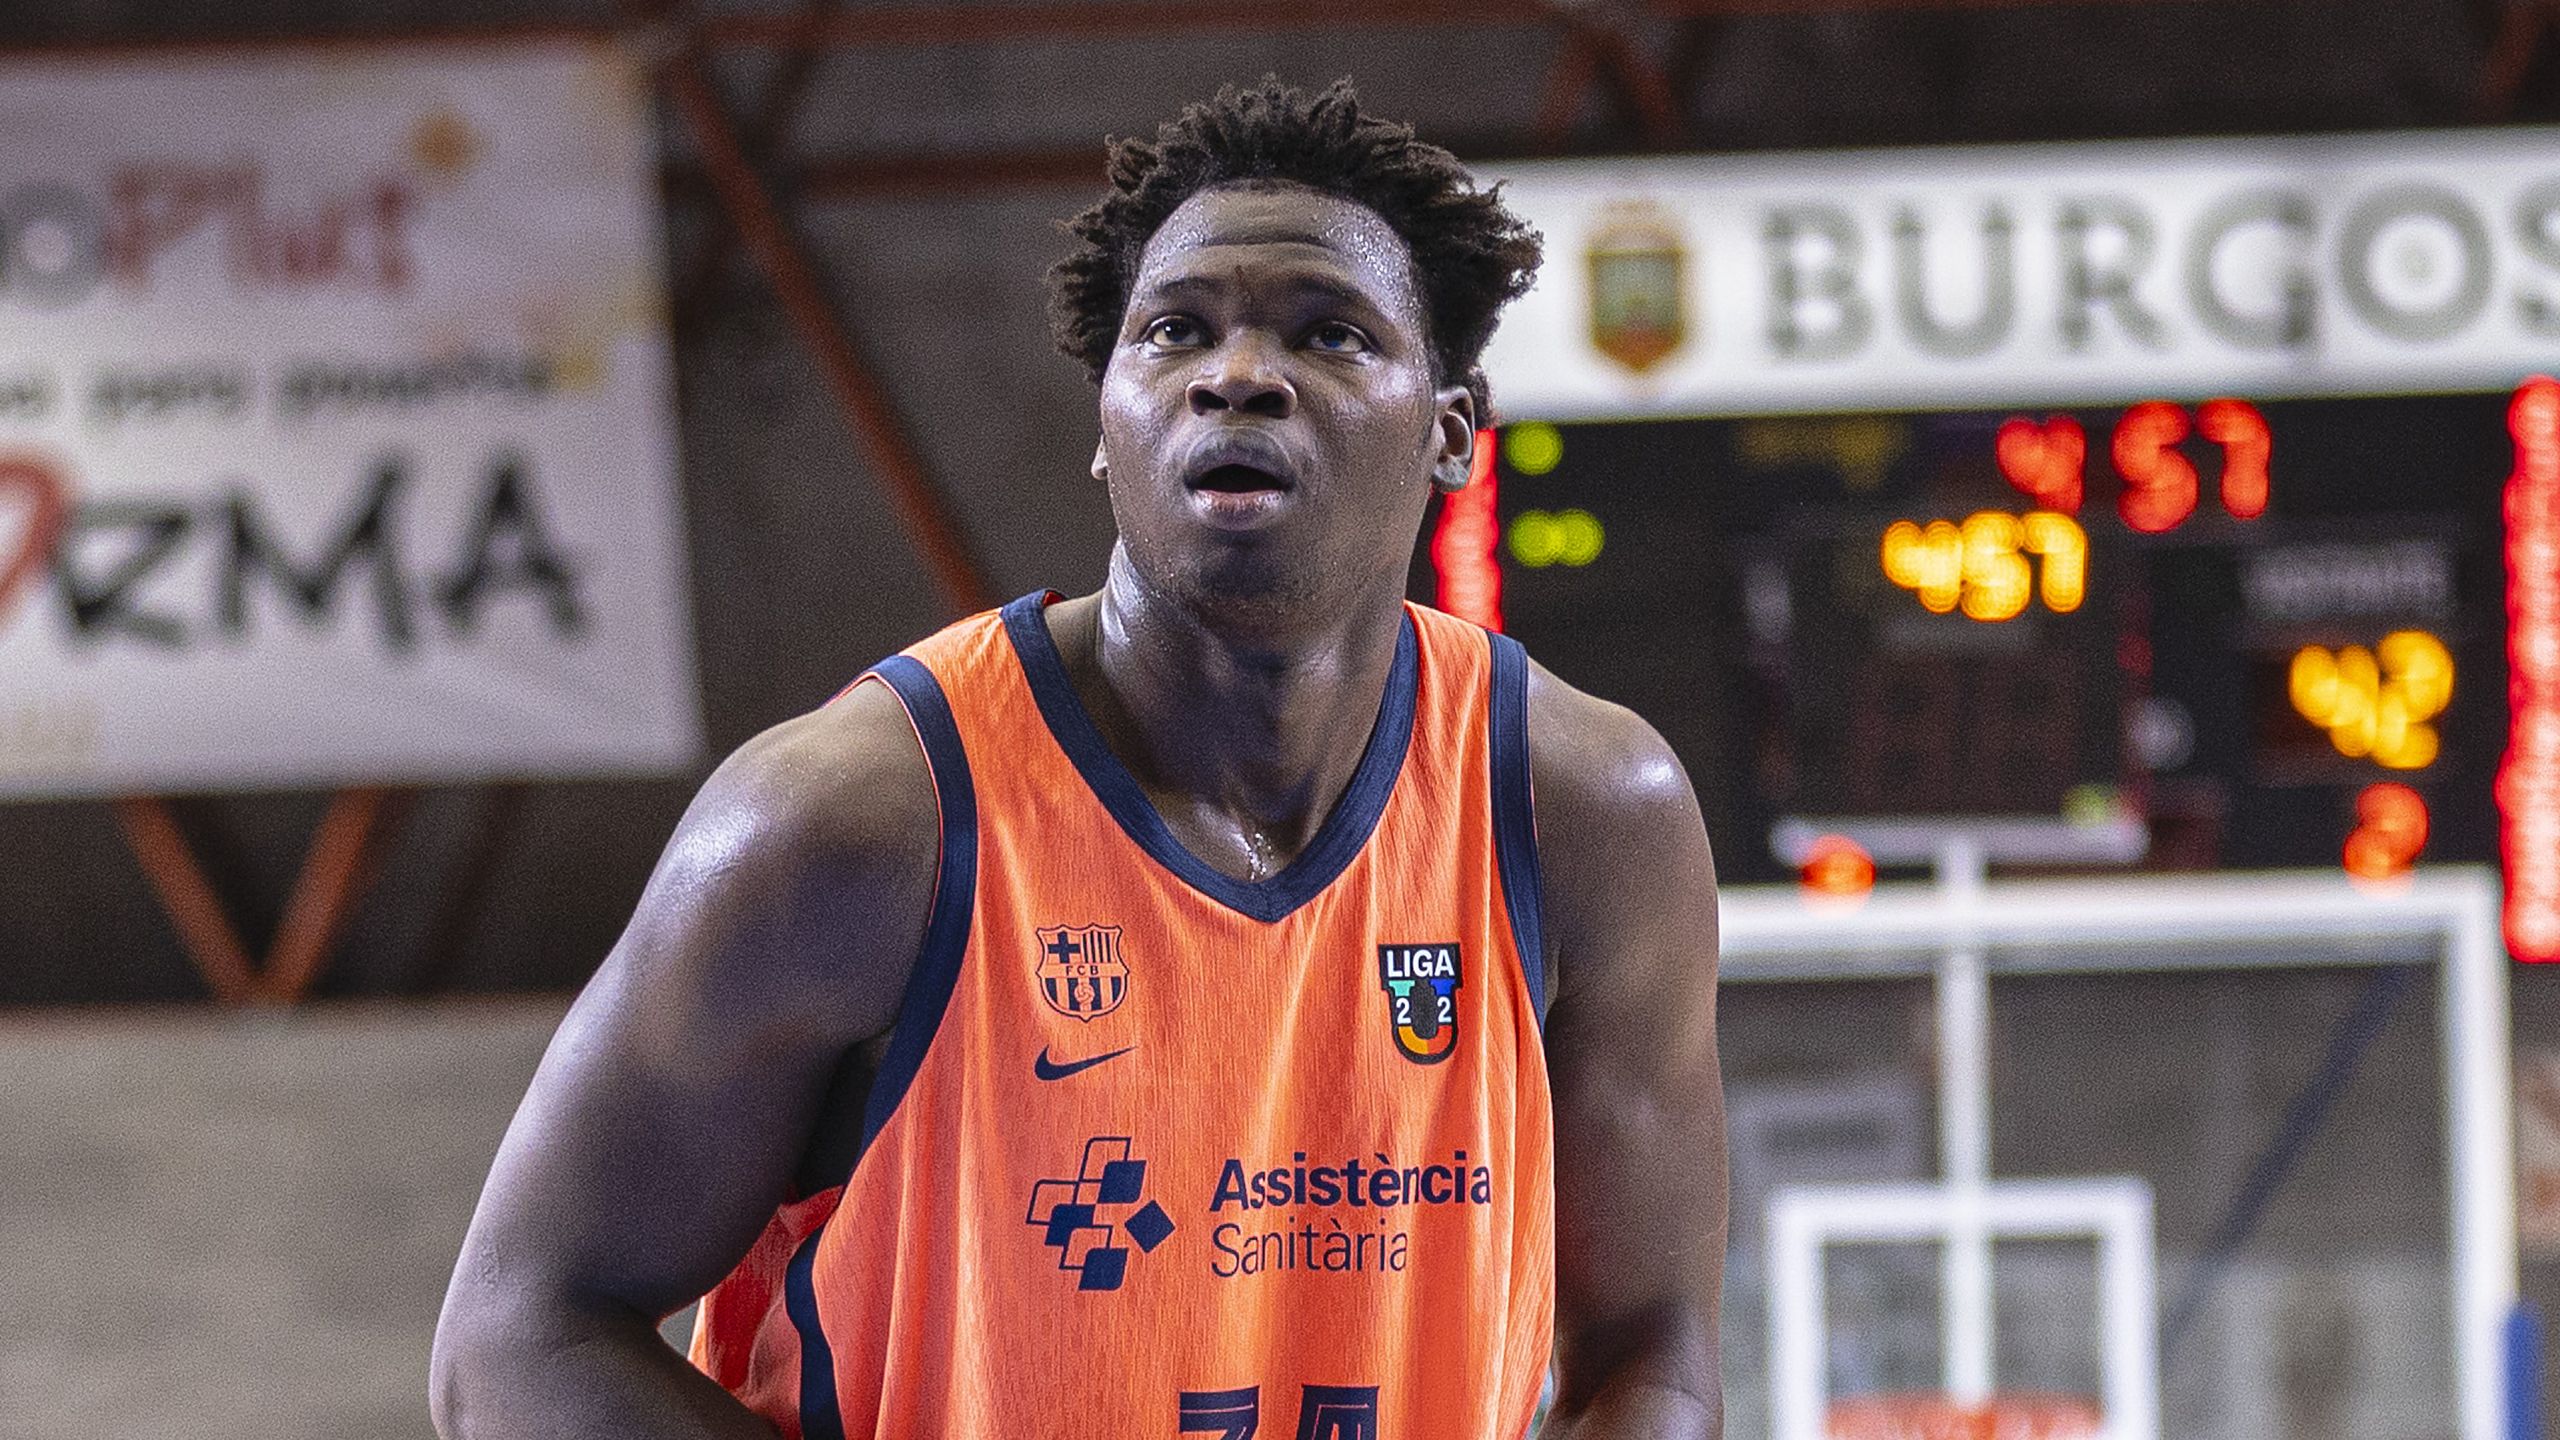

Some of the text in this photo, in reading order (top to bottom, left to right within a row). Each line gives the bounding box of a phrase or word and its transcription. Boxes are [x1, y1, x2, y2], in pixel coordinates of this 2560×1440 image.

[1386, 949, 1455, 977] LIGA
[1209, 1150, 1492, 1212] Assistència
[1211, 1216, 1408, 1278] Sanitària
